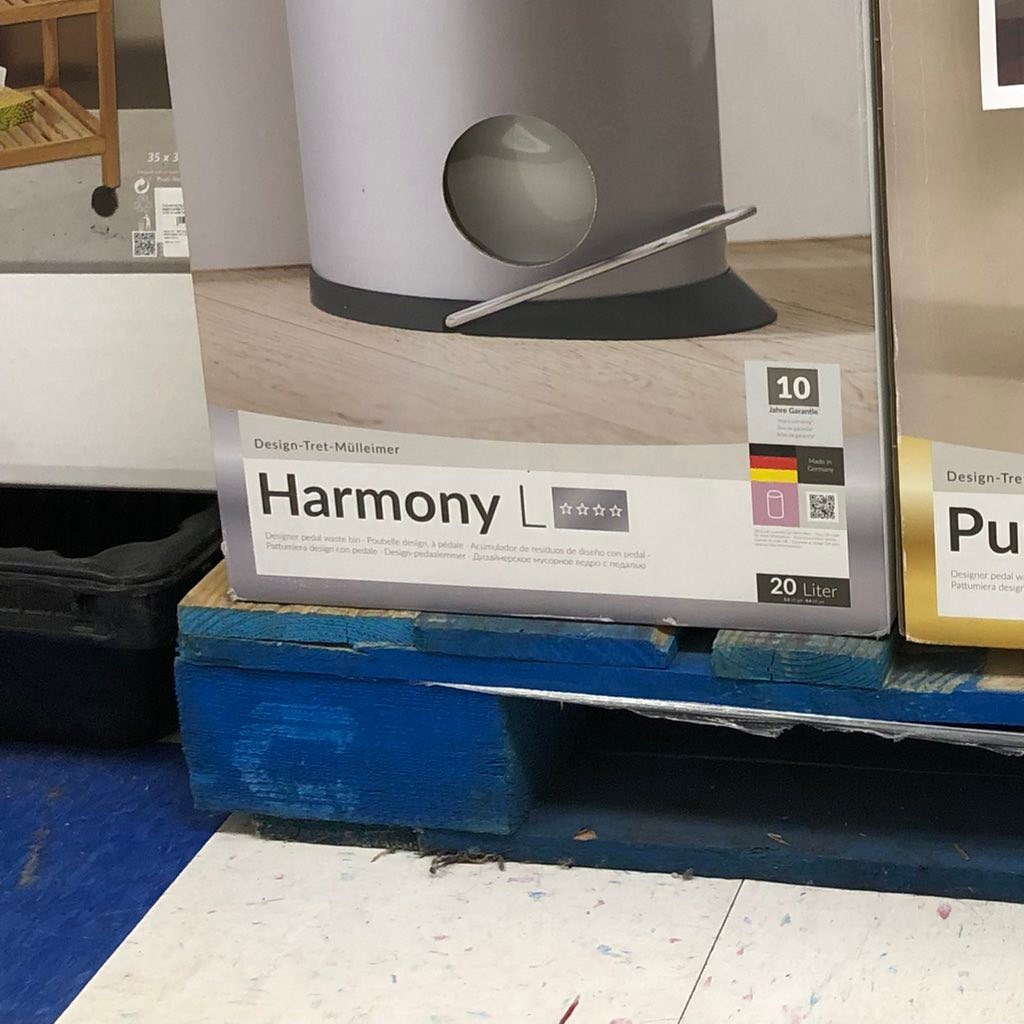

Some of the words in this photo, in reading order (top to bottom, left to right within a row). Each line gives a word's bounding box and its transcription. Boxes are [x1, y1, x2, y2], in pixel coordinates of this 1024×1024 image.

[147, 152, 160, 162] 35
[777, 375, 811, 399] 10
[253, 438, 400, 456] Design-Tret-Mülleimer
[258, 472, 501, 535] Harmony
[519, 484, 547, 528] L
[951, 570, 988, 581] Designer
[990, 571, 1014, 582] pedal
[770, 577, 797, 595] 20
[803, 582, 838, 598] Liter
[951, 581, 996, 591] Pattumiera
